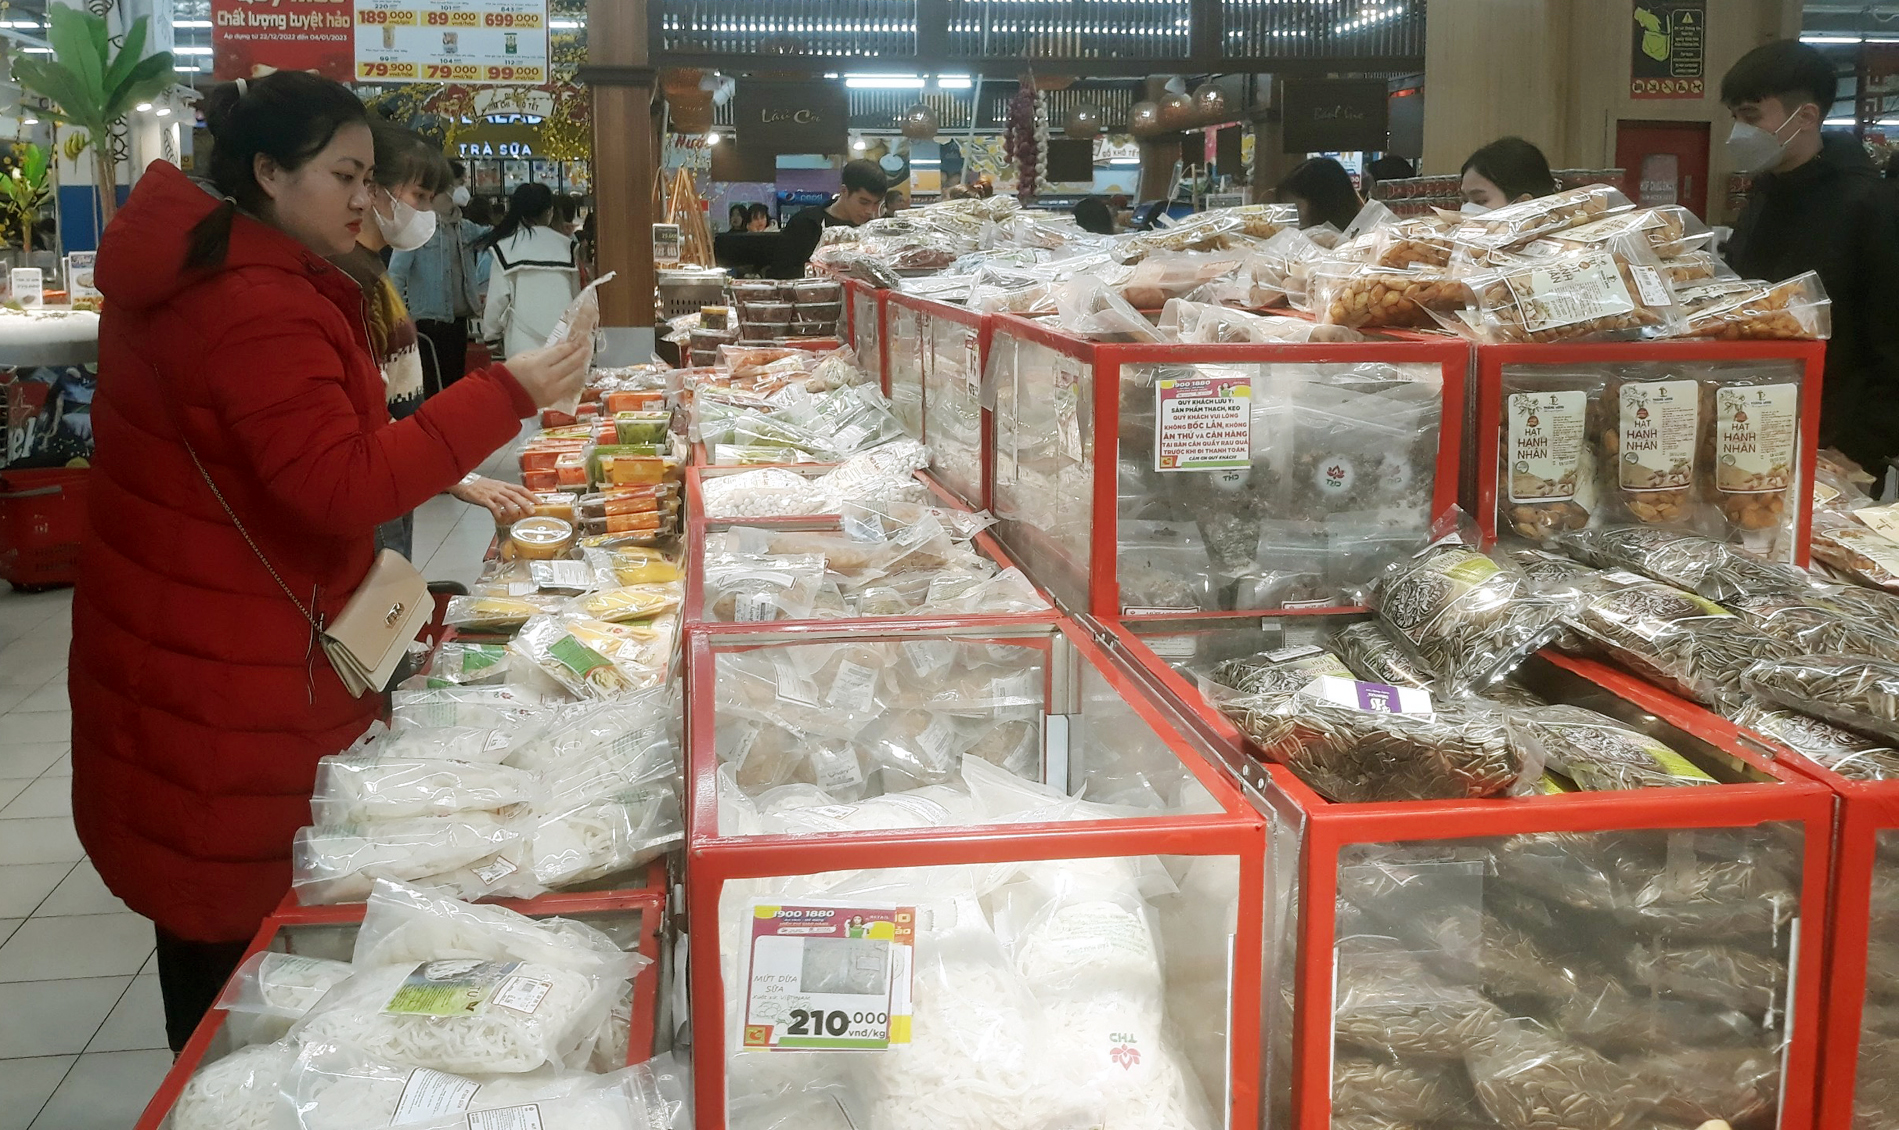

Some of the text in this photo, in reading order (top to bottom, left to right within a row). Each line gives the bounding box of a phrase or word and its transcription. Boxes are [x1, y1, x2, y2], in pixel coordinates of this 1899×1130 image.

[218, 7, 350, 30] Chất lượng tuyệt hảo
[460, 141, 532, 156] TRÀ SỮA
[1188, 420, 1204, 429] BỐC
[1627, 440, 1658, 450] NHÂN
[1724, 443, 1756, 453] NHÂN
[1518, 449, 1548, 459] NHÂN
[753, 974, 797, 982] MỨT DỪA
[766, 984, 784, 992] SỮA
[848, 1024, 886, 1038] vnđ/kg
